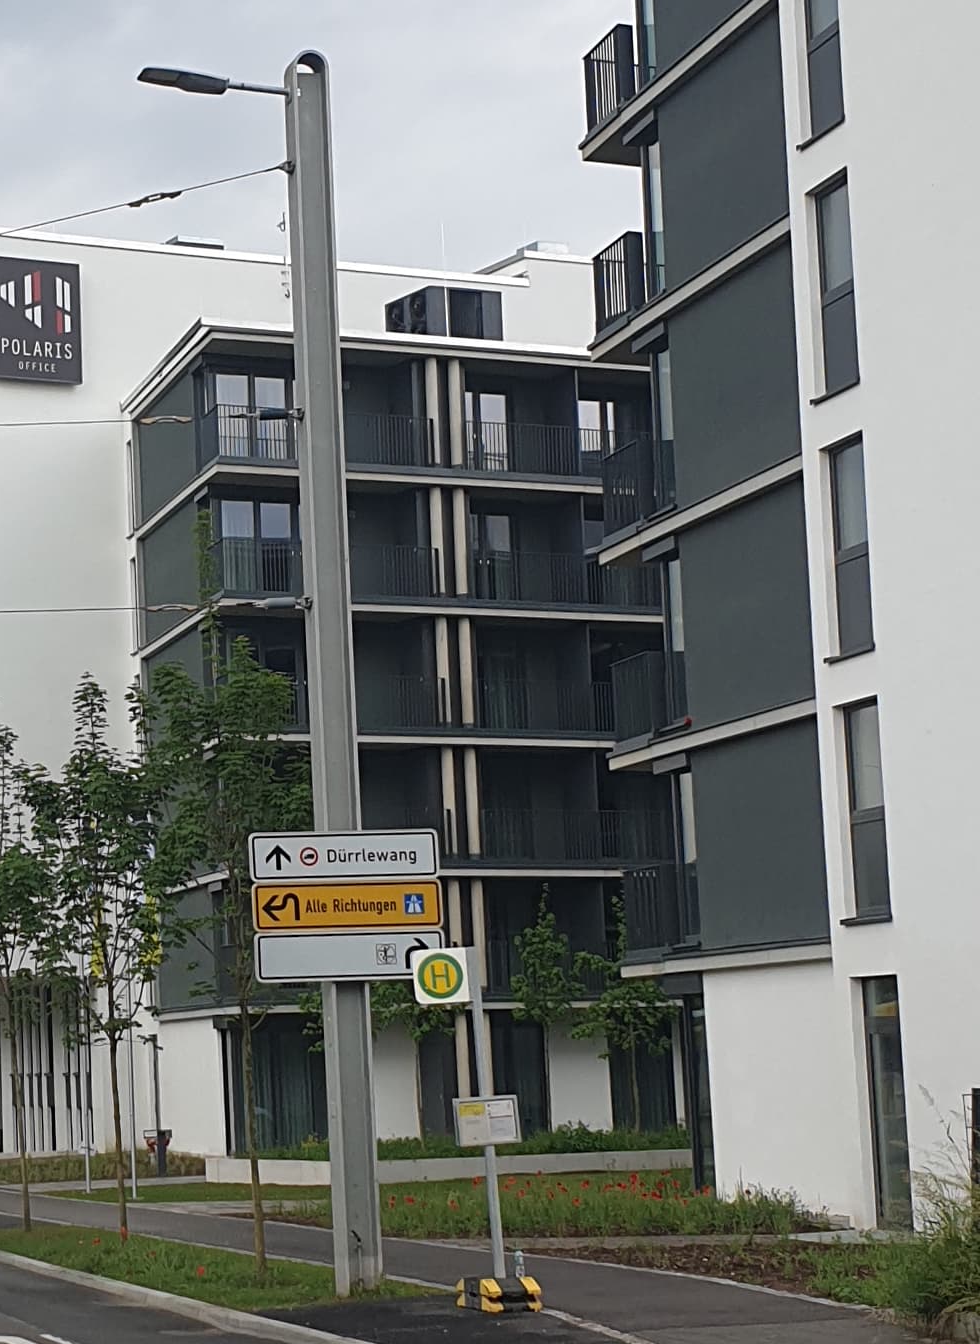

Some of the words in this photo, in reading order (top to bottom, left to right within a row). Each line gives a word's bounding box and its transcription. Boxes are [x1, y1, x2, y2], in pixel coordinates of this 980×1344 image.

[1, 337, 73, 360] POLARIS
[18, 361, 56, 373] OFFICE
[326, 848, 417, 865] Dürrlewang
[305, 899, 328, 913] Alle
[332, 898, 397, 915] Richtungen
[430, 962, 452, 989] H
